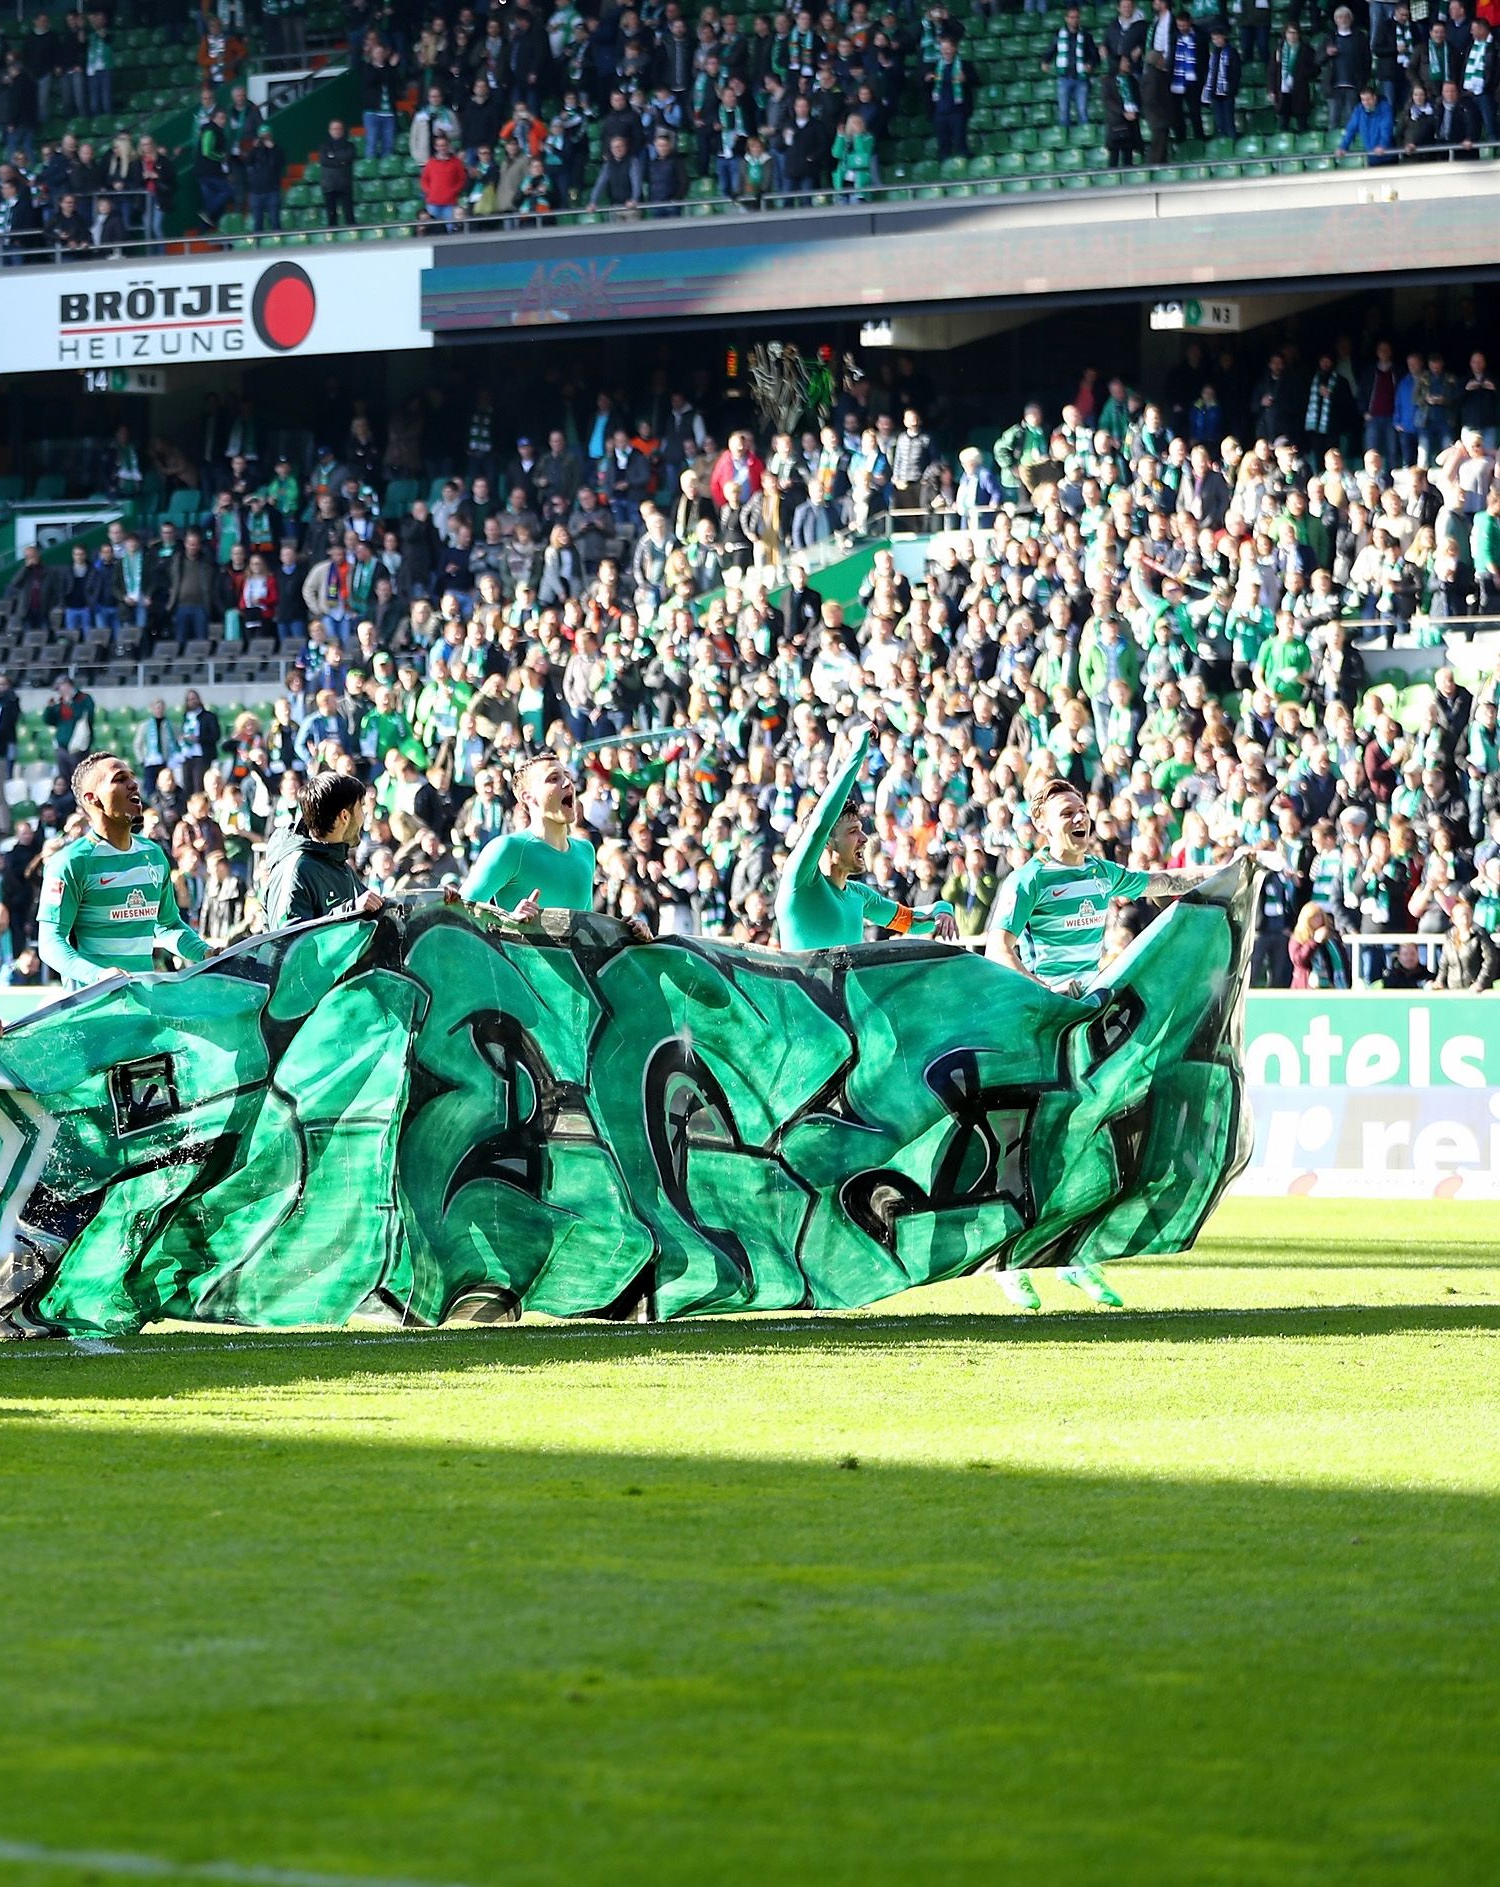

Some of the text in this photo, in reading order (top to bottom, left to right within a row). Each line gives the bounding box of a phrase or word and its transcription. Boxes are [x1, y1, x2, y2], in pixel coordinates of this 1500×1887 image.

[60, 281, 244, 323] BRÖTJE
[59, 329, 246, 363] HEIZUNG
[84, 369, 108, 392] 14
